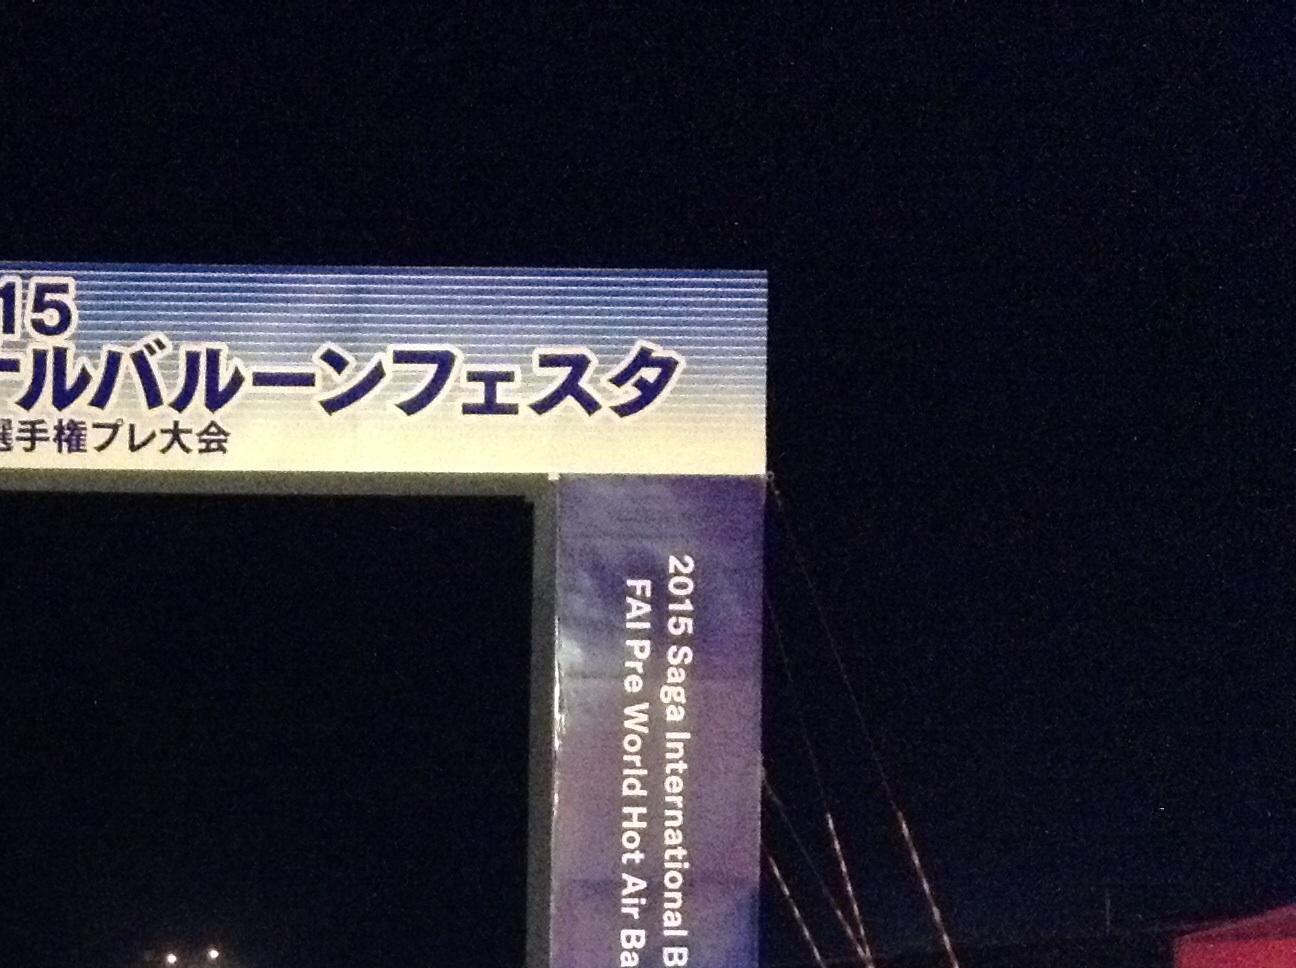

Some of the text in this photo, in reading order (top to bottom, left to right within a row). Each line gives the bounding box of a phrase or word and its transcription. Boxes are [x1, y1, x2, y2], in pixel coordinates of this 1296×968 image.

[625, 579, 652, 628] FAI
[667, 555, 695, 636] 2015
[623, 639, 651, 693] Pre
[659, 645, 693, 722] Saga
[622, 702, 650, 796] World
[621, 806, 648, 864] Hot
[662, 732, 691, 936] International
[620, 873, 648, 919] Air
